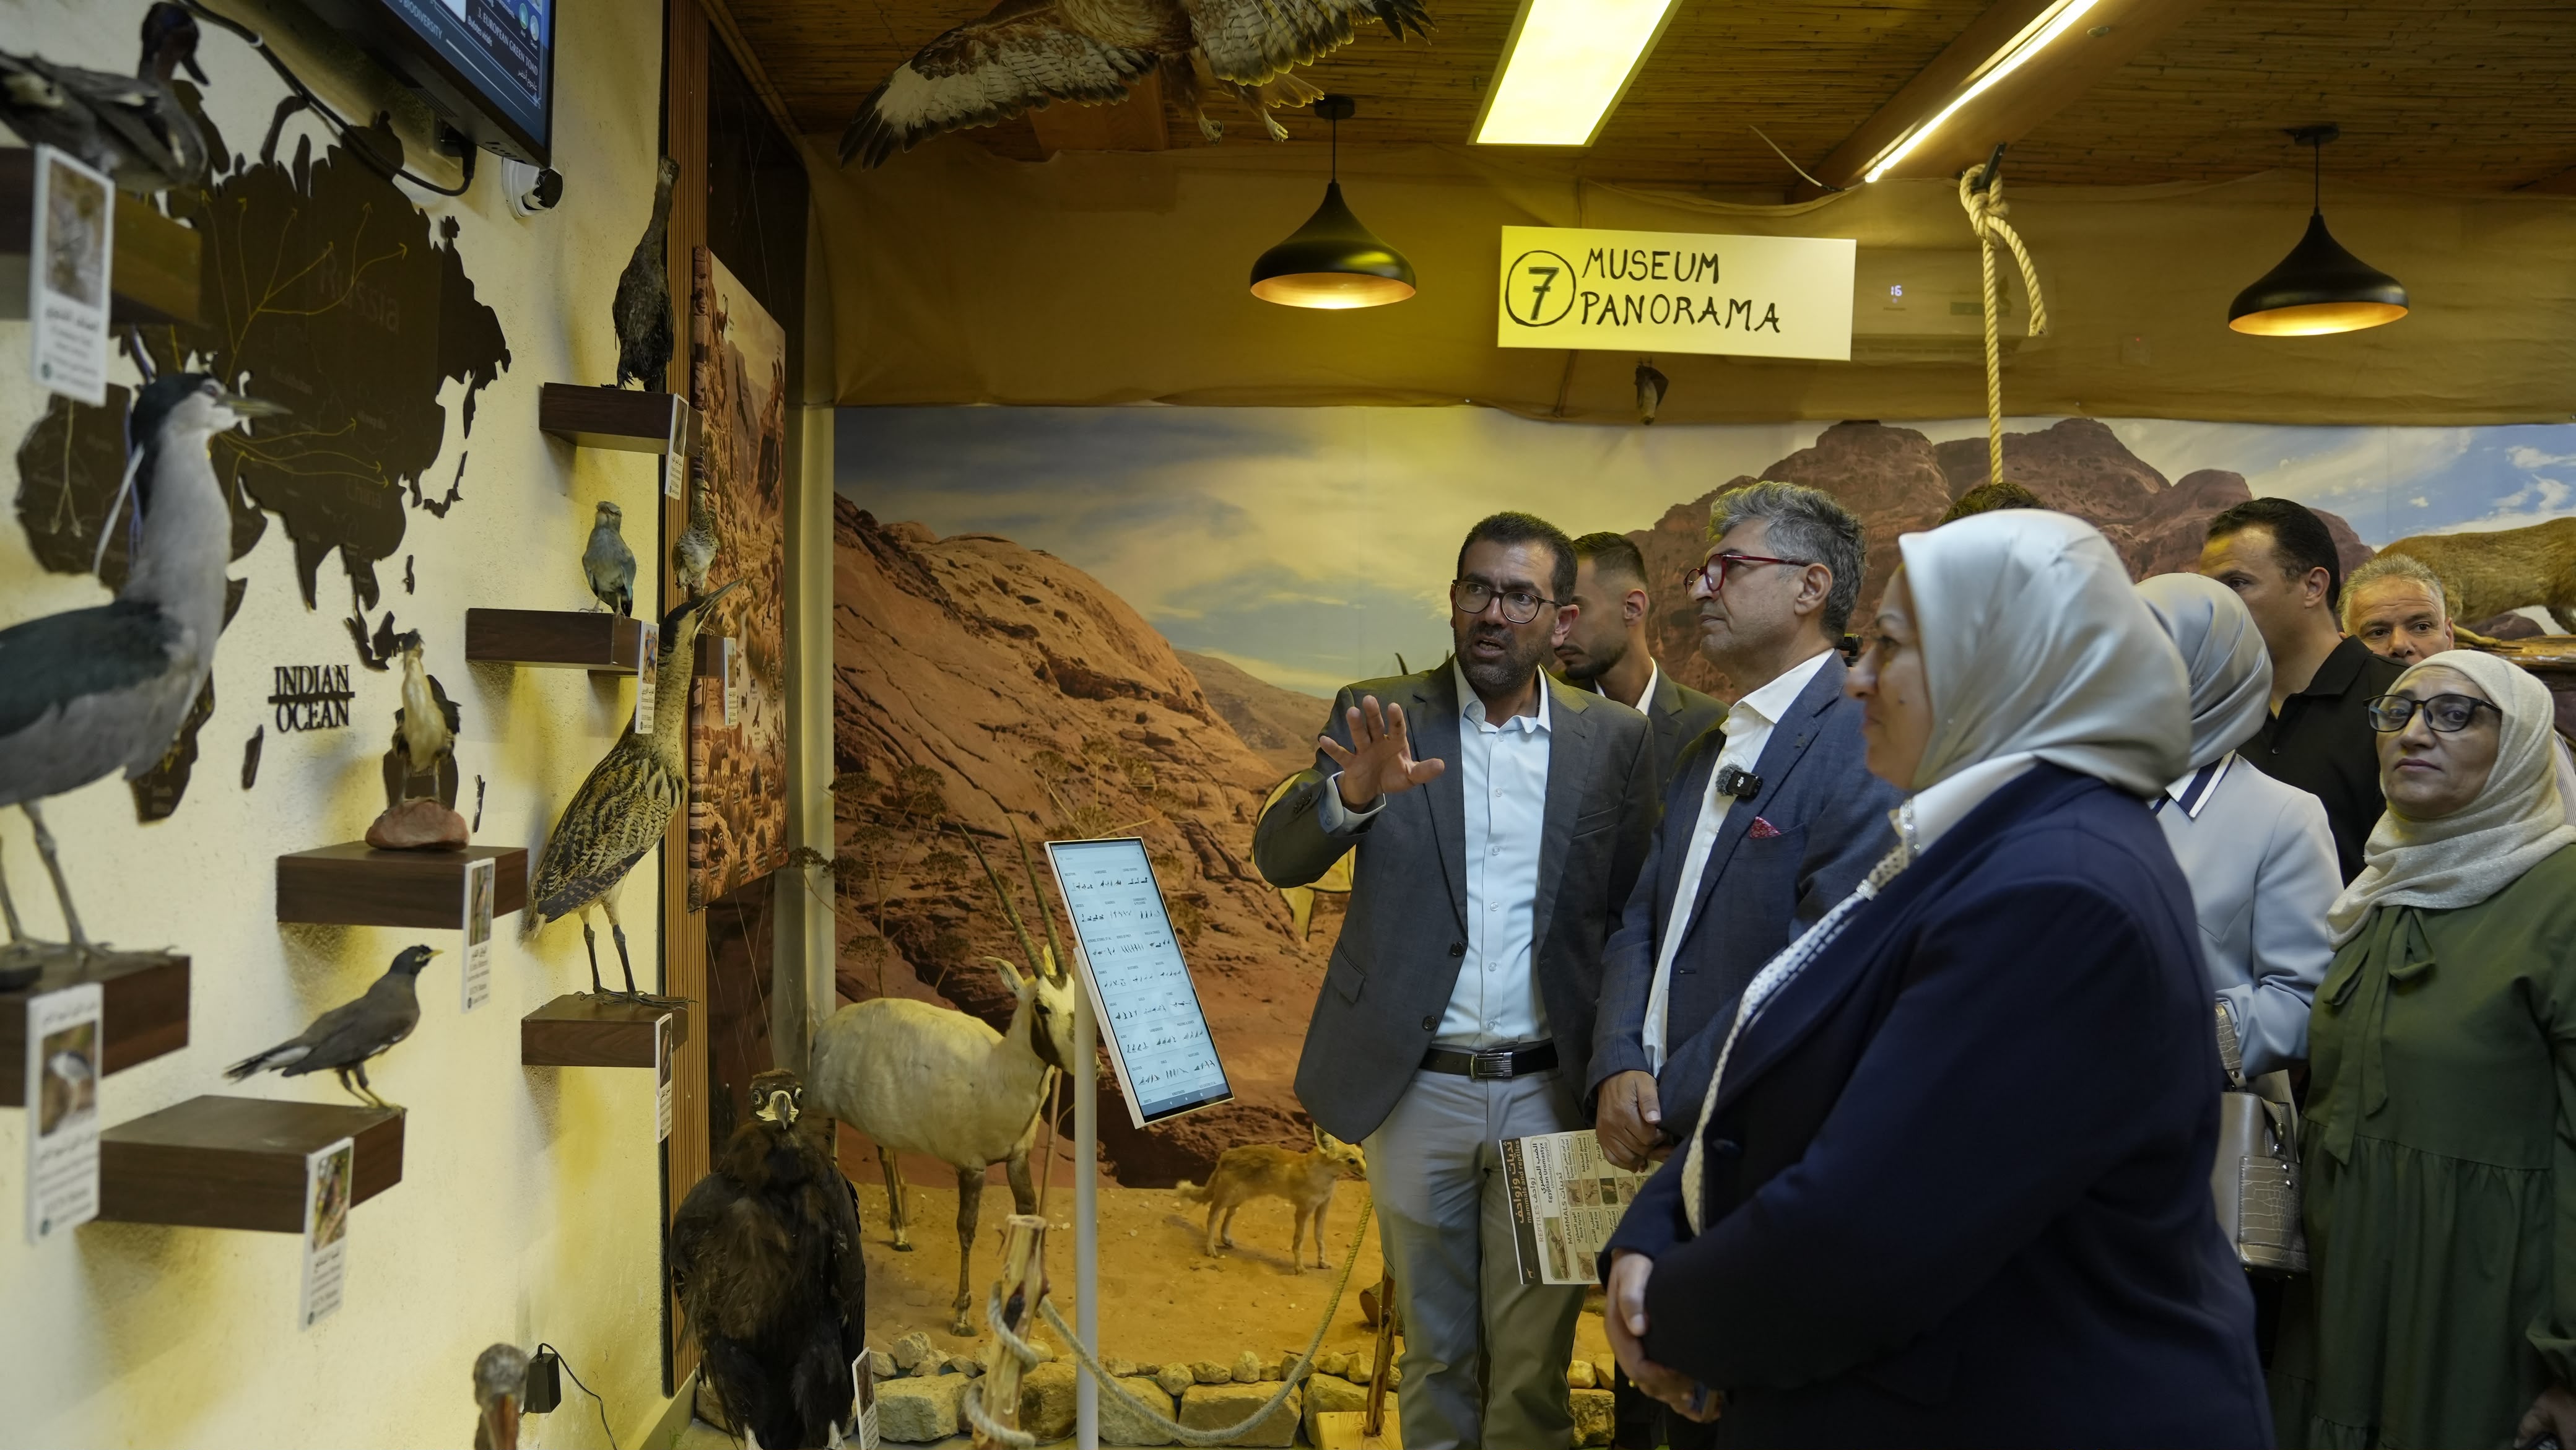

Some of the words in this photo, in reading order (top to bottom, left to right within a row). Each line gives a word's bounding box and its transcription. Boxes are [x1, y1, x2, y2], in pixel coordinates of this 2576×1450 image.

[403, 0, 443, 40] BIODIVERSITY
[483, 12, 509, 46] EUROPEAN
[509, 40, 525, 63] GREEN
[525, 56, 538, 76] TOAD
[1582, 248, 1720, 284] MUSEUM
[1528, 266, 1559, 321] 7
[1891, 285, 1902, 297] 16
[1580, 291, 1780, 333] PANORAMA
[274, 664, 349, 695] INDIAN
[276, 700, 349, 732] OCEAN
[1533, 1144, 1541, 1164] الضب
[1539, 1143, 1547, 1175] Uromastyx
[1529, 1178, 1538, 1203] زواحف
[1536, 1166, 1547, 1194] المصري
[1512, 1178, 1524, 1223] وزواحف
[1522, 1187, 1532, 1223] mammals
[1534, 1205, 1544, 1242] REPTILES
[1562, 1201, 1572, 1244] MAMMALS
